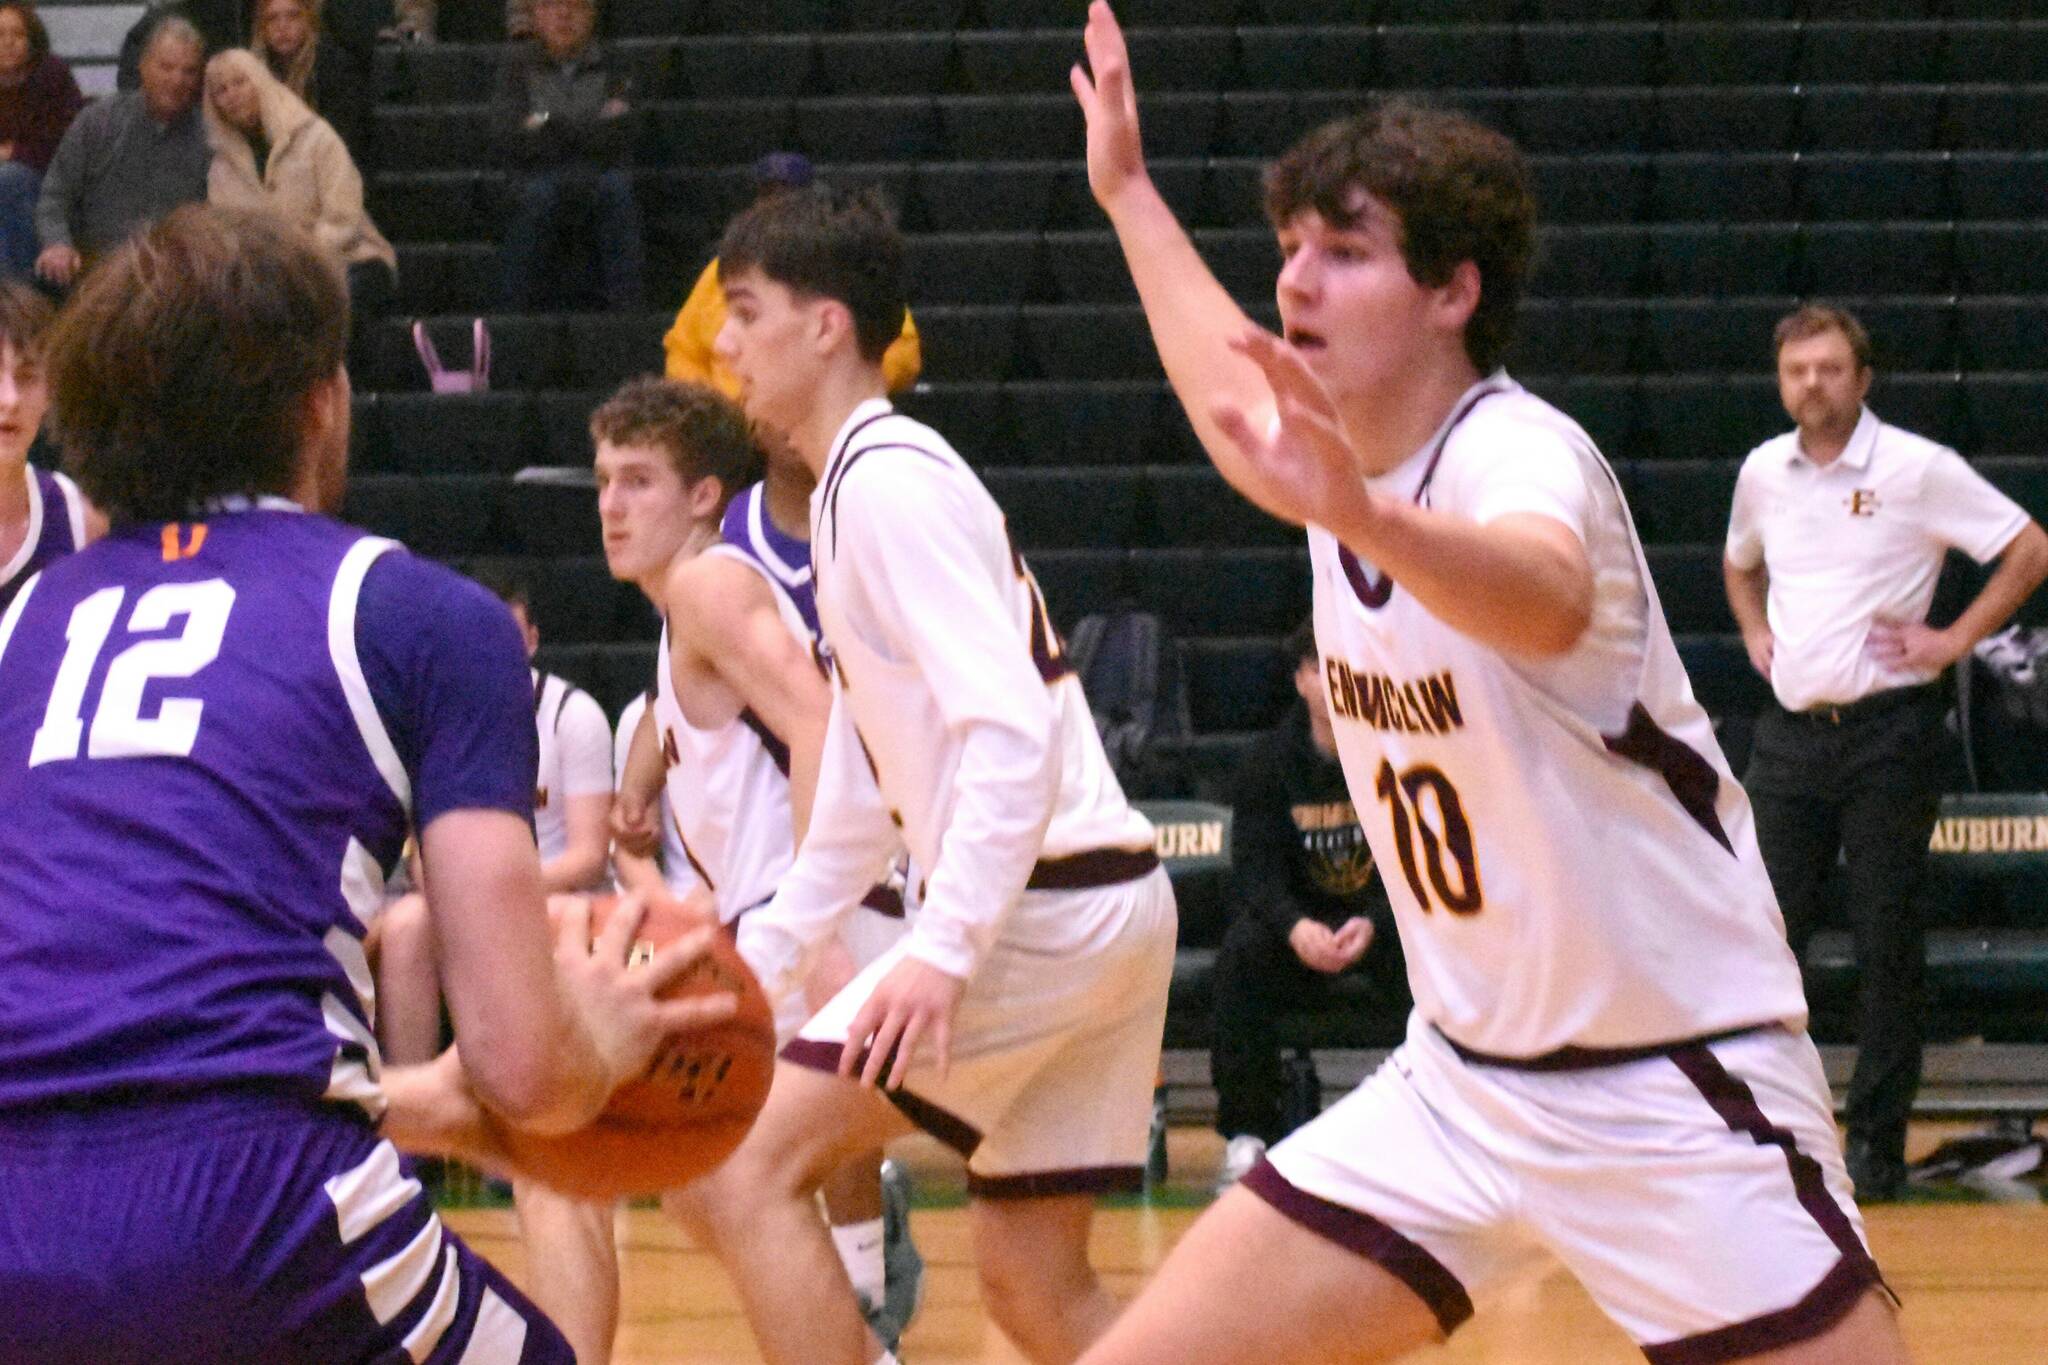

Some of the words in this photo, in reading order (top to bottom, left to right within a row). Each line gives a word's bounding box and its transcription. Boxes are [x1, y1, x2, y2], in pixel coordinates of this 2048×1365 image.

[1849, 488, 1875, 517] E
[29, 578, 236, 768] 12
[1156, 822, 1223, 857] URN
[1375, 757, 1483, 916] 10
